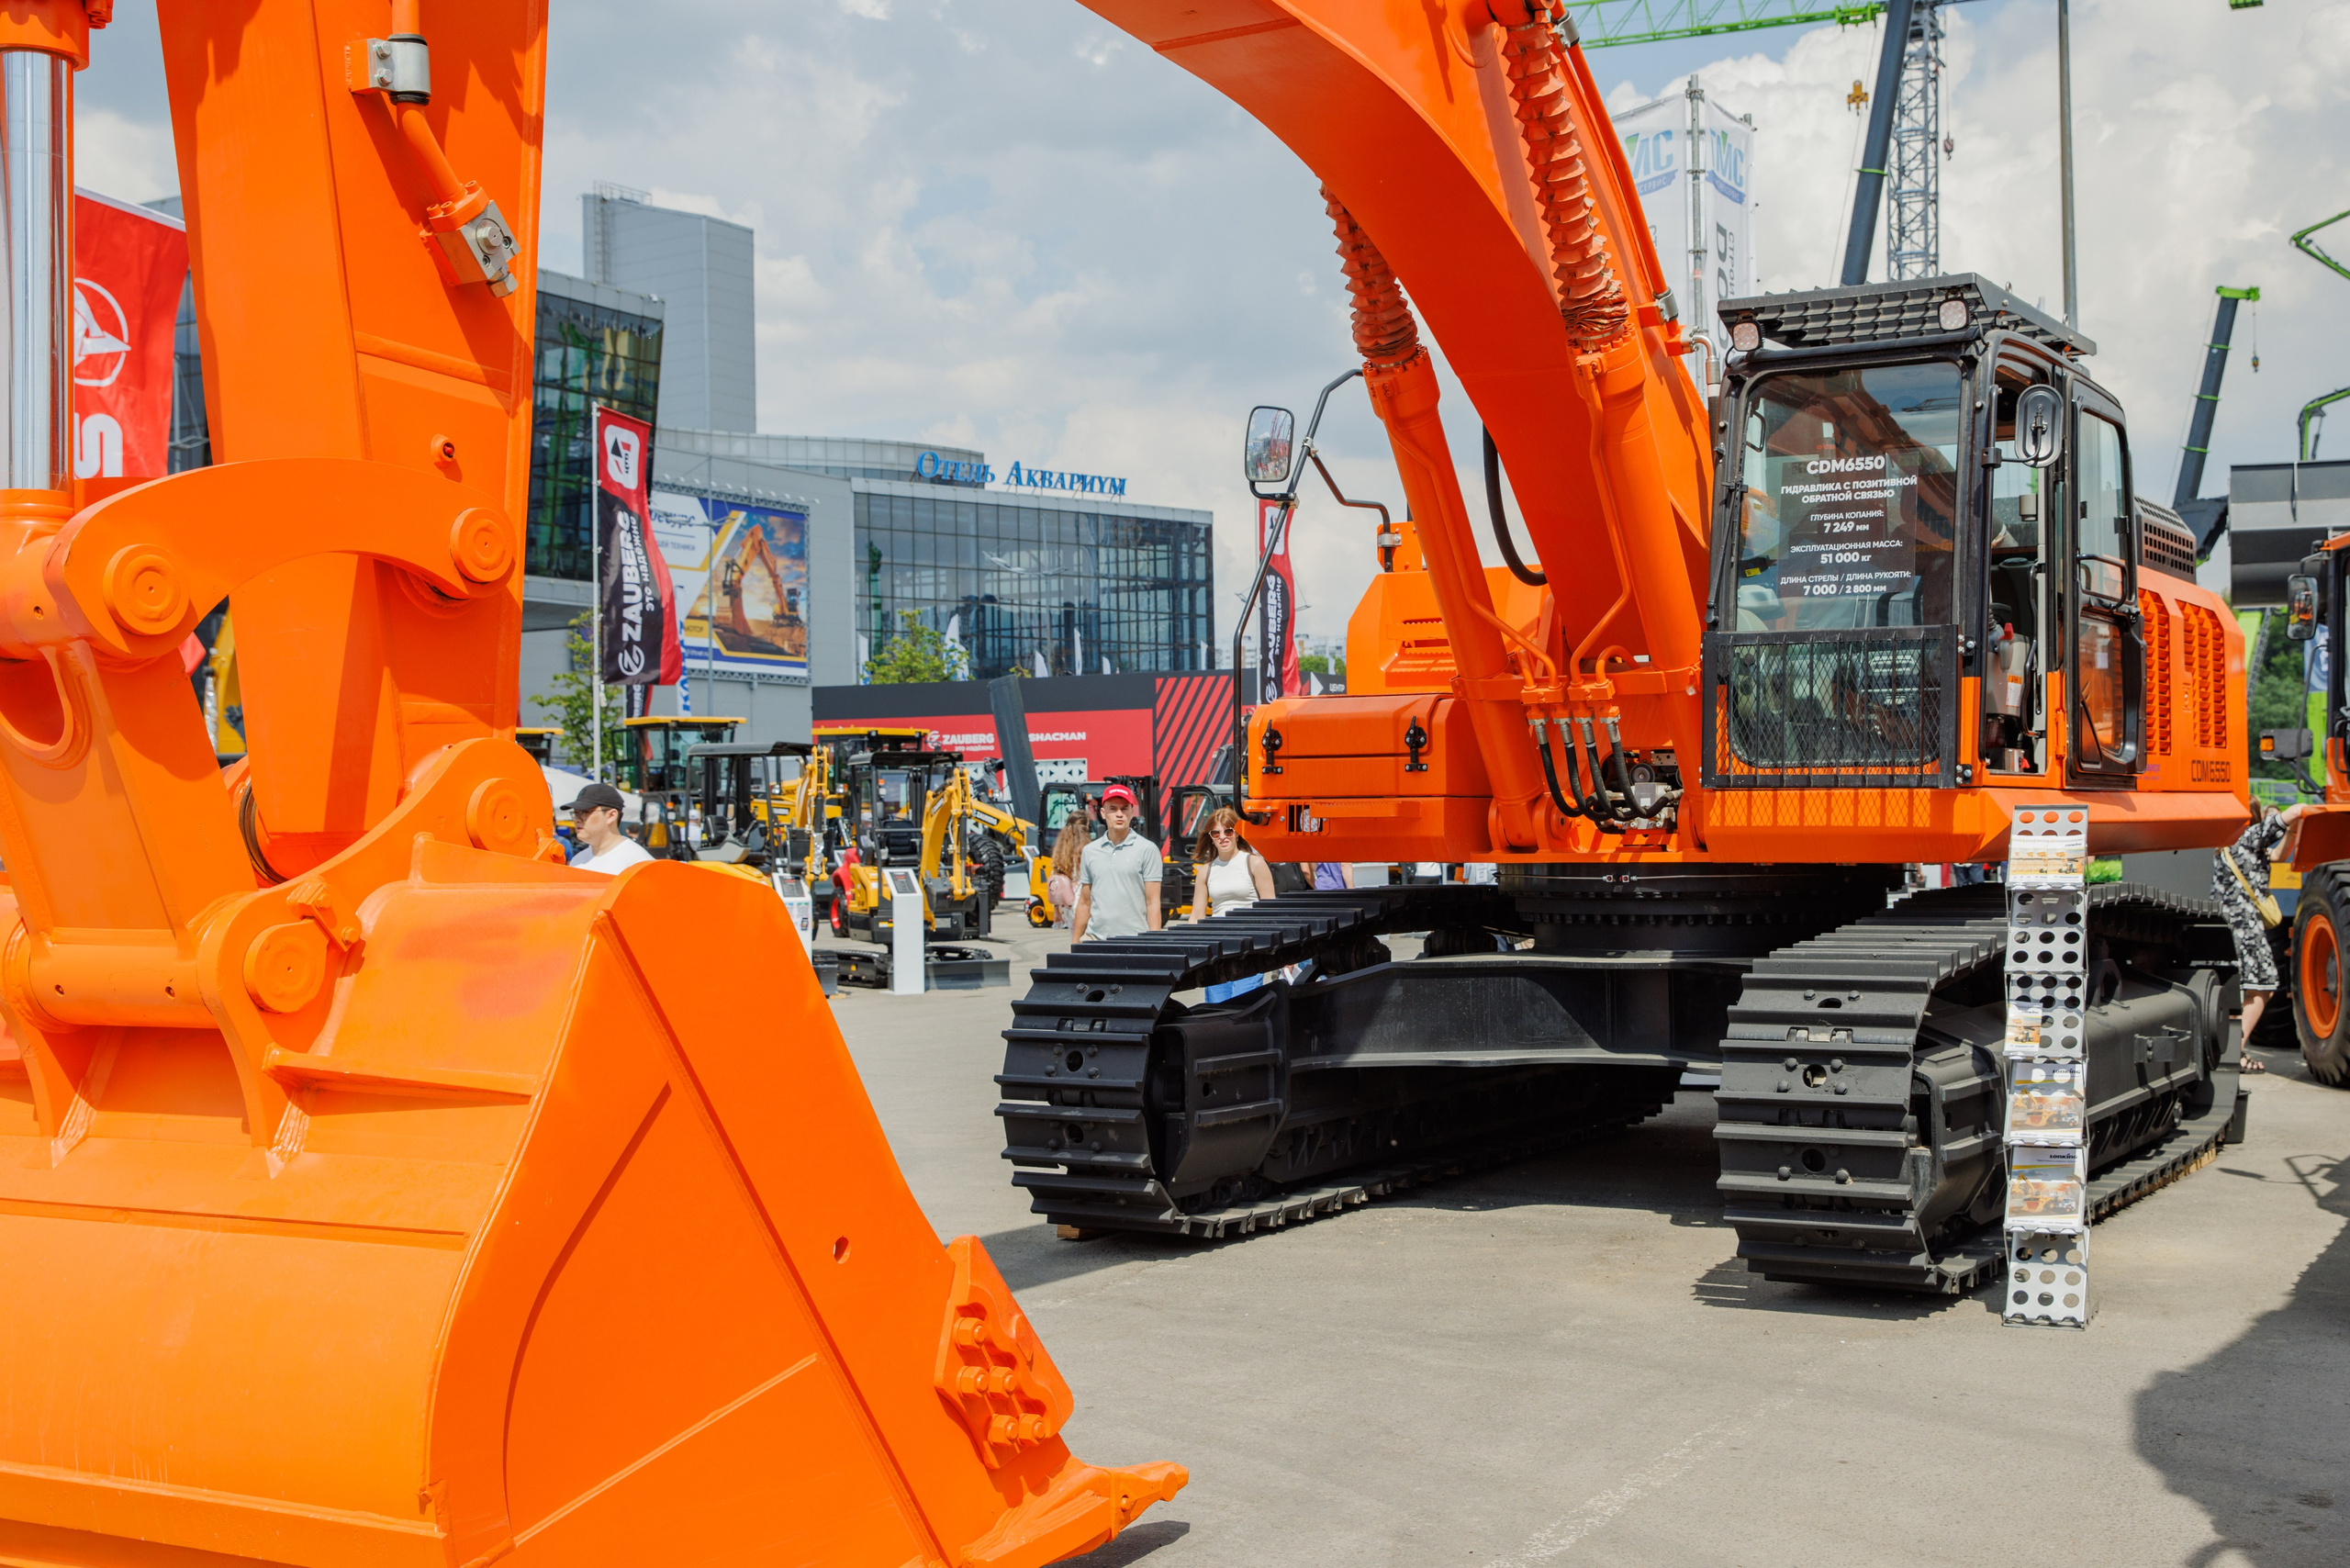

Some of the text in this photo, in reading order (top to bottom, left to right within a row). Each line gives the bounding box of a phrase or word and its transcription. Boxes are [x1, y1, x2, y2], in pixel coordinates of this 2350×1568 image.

[1806, 455, 1886, 475] CDM6550
[1781, 475, 1918, 495] ГИДРАВЛИКА С ПОЗИТИВНОЙ
[1801, 489, 1895, 504] ОБРАТНОЙ СВЯЗЬЮ
[1810, 510, 1885, 521] ГЛУБИНА КОПАНИЯ:
[1823, 523, 1830, 533] 7
[1832, 521, 1854, 532] 249
[1790, 540, 1903, 554] ЭКСПЛУАТАЦИОННАЯ МАССА:
[1819, 552, 1872, 565] 51 000 кг
[616, 510, 643, 643] ZAUBERG
[1780, 577, 1807, 585] ДЛИНА
[1807, 574, 1839, 583] СТРЕЛЫ
[1845, 573, 1873, 582] ДЛИНА
[1874, 571, 1911, 579] РУКОЯТИ:
[1803, 586, 1810, 596] 7
[1812, 584, 1837, 596] 000
[1845, 585, 1852, 593] 2
[1852, 584, 1872, 593] 800
[1266, 574, 1277, 678] ZAUBERG
[942, 733, 994, 745] ZAUBERG
[1028, 732, 1087, 742] SHACMAN
[2191, 759, 2231, 782] CDM6550
